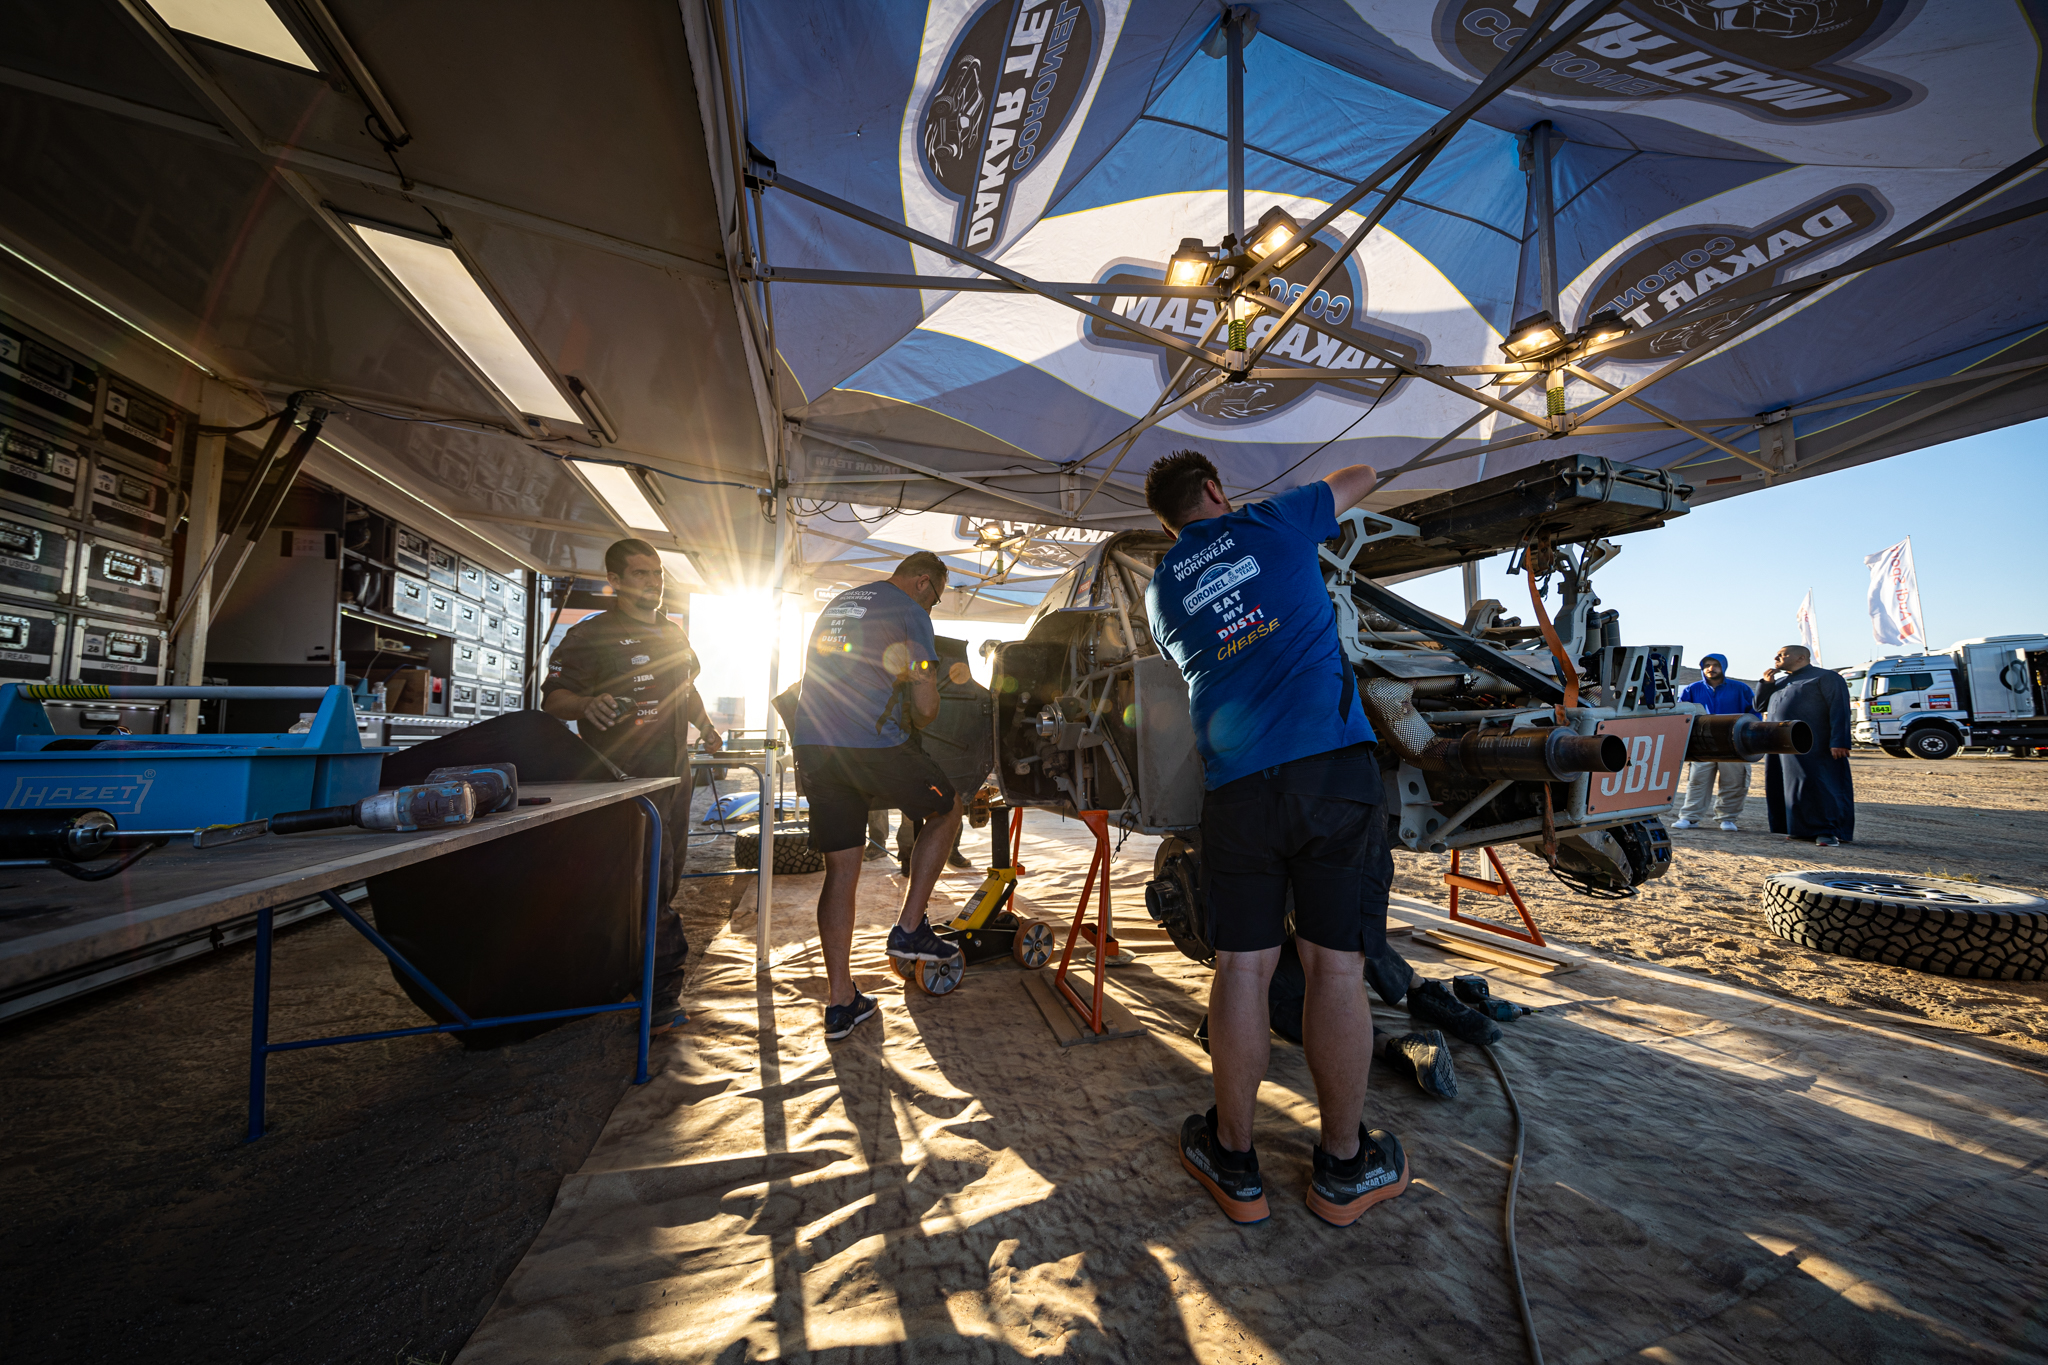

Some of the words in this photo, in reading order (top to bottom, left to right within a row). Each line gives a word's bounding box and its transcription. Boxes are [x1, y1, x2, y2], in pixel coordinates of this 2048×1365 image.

[2, 347, 9, 356] 7
[20, 373, 67, 400] POWERFLEX
[114, 404, 120, 413] 8
[9, 465, 38, 480] BOOTS
[58, 465, 71, 475] 15
[99, 482, 111, 491] 16
[112, 501, 151, 518] WINDSCREEN
[9, 558, 31, 571] USED
[1175, 538, 1236, 582] WORKWEAR
[1235, 561, 1252, 574] DAKAR
[1240, 566, 1254, 577] TEAM
[1187, 578, 1228, 609] CORONEL
[1212, 590, 1241, 614] EAT
[1222, 603, 1244, 622] MY
[1217, 608, 1265, 640] DUST!
[1217, 618, 1281, 661] CHEESE
[7, 650, 32, 661] (REAR)
[87, 644, 100, 653] 28
[101, 663, 129, 672] UPRIGHT
[1600, 734, 1671, 797] JBL
[19, 785, 138, 807] HAZET
[1356, 1176, 1380, 1193] DAKAR
[1378, 1170, 1398, 1184] TEAM
